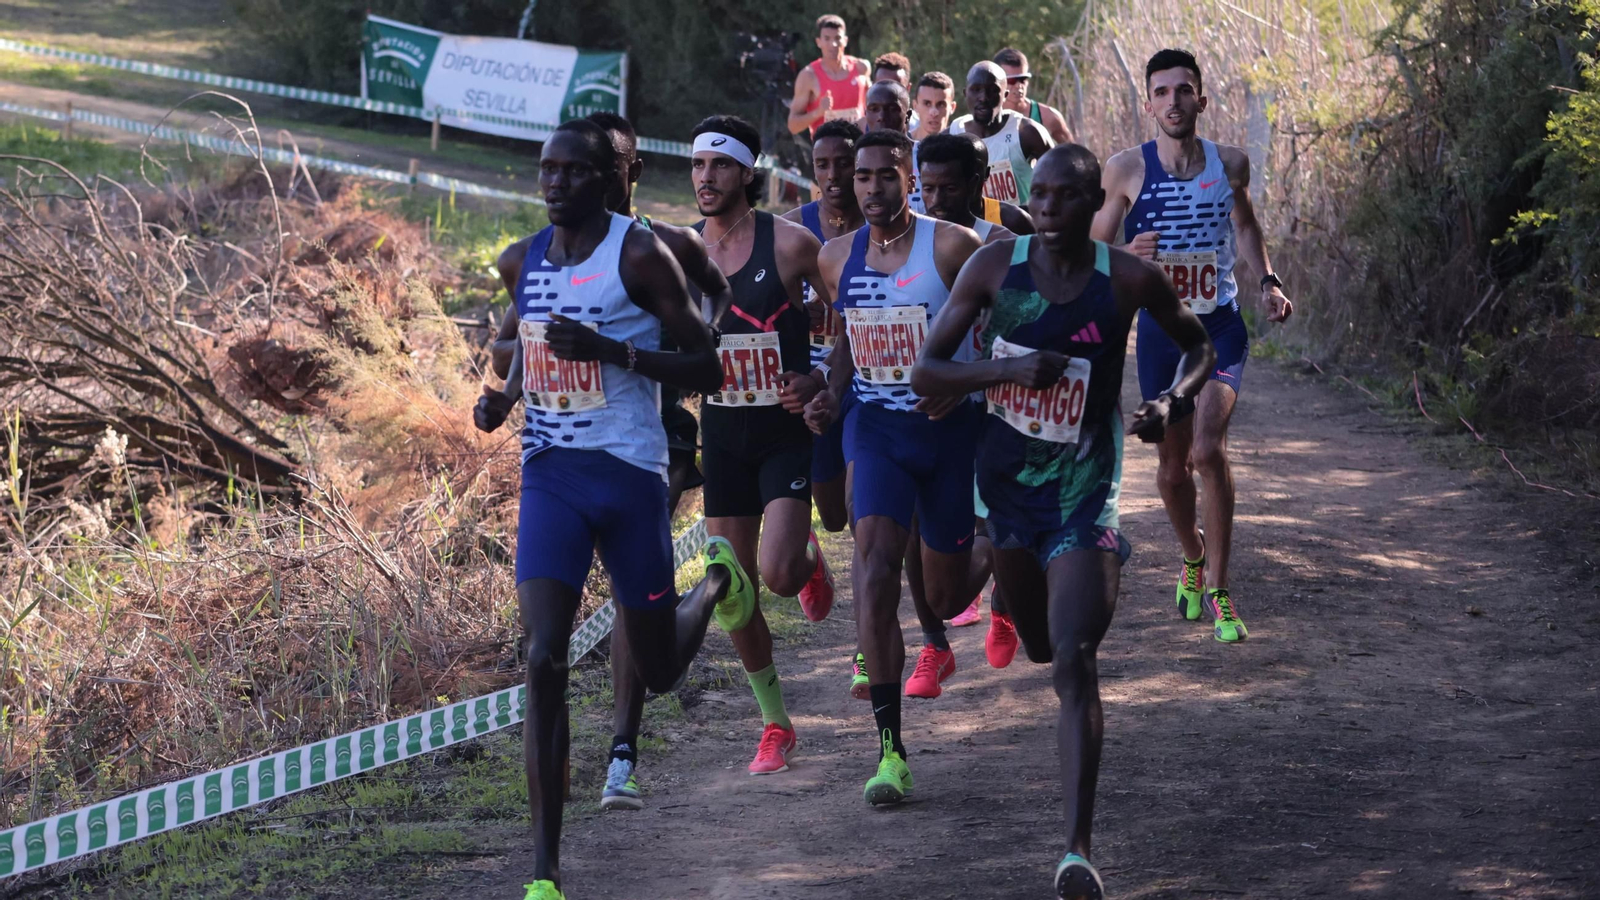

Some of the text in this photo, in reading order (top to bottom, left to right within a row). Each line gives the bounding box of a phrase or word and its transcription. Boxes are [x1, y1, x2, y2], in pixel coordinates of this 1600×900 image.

[368, 68, 416, 91] SEVILLA
[441, 52, 565, 87] DIPUTACIÓN DE
[462, 88, 527, 116] SEVILLA
[1164, 264, 1217, 300] BIC
